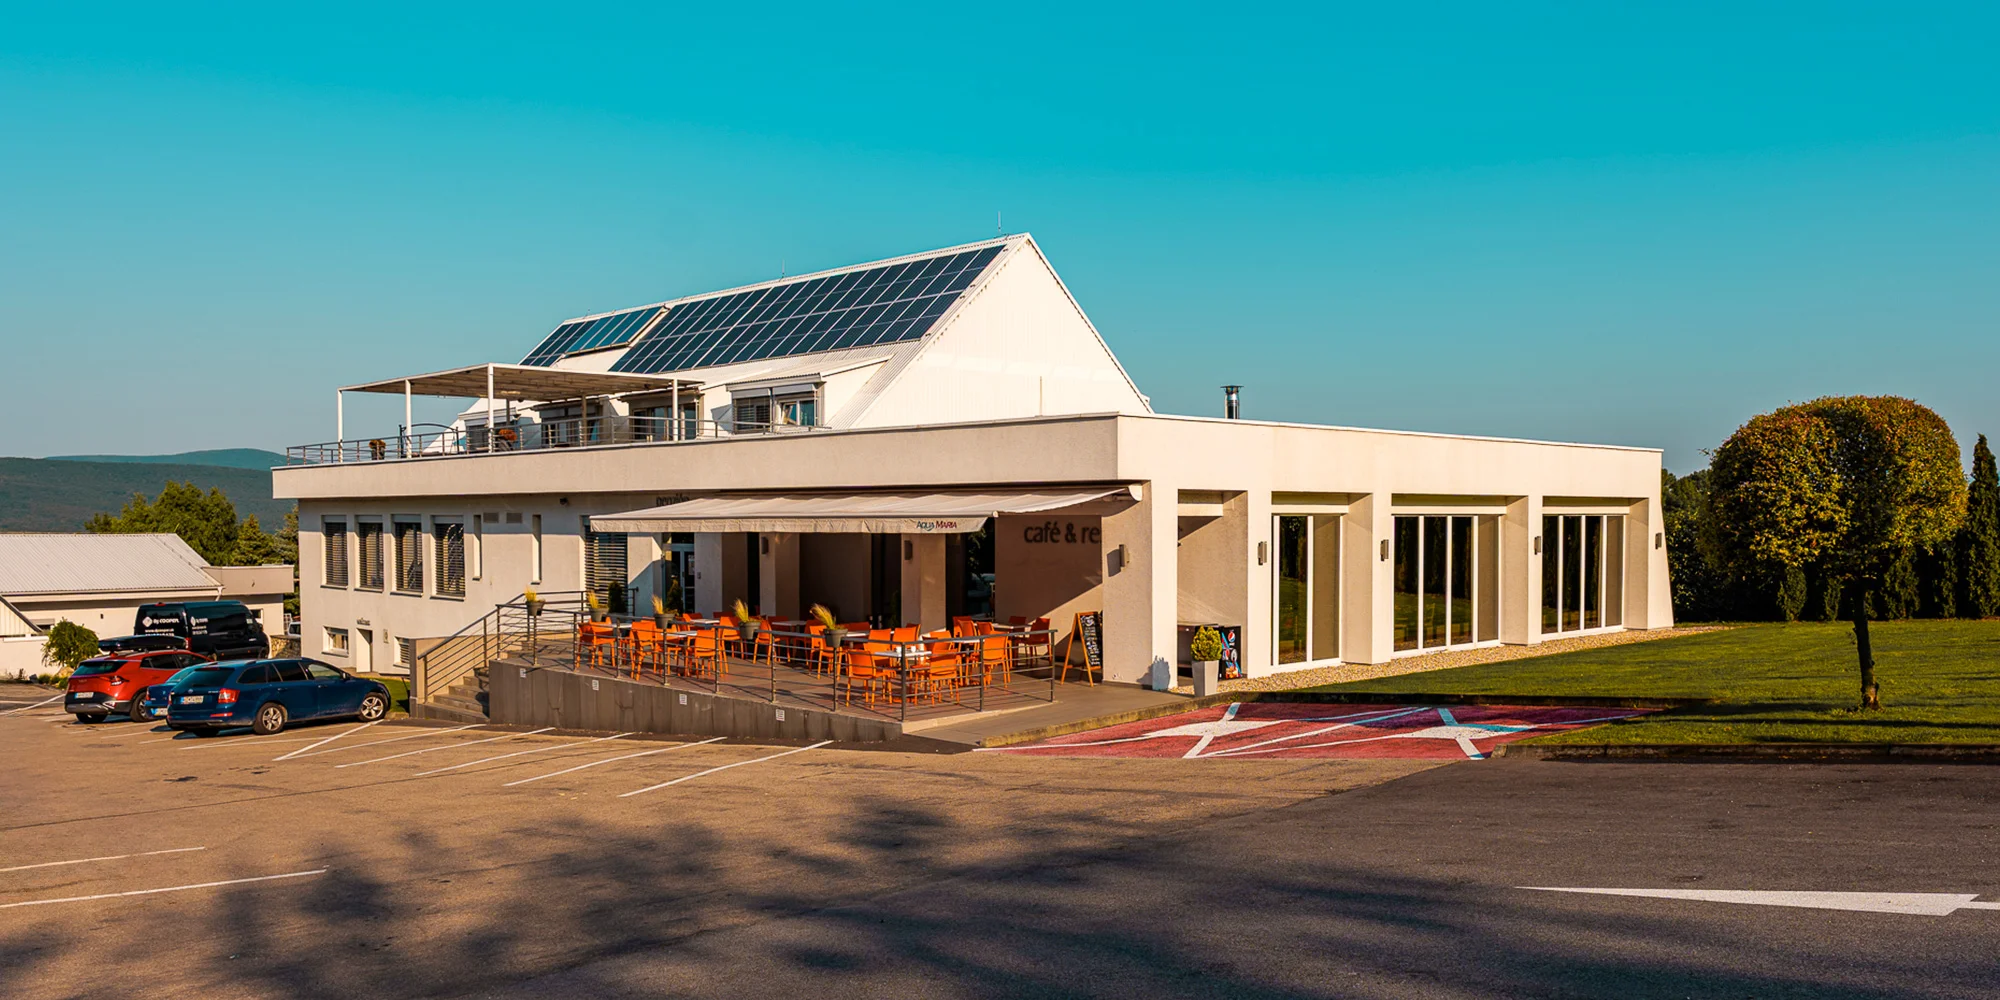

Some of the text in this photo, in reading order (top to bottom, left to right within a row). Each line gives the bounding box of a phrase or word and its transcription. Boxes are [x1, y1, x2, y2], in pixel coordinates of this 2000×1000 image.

[936, 520, 957, 529] MARIA
[1024, 521, 1102, 544] café & re
